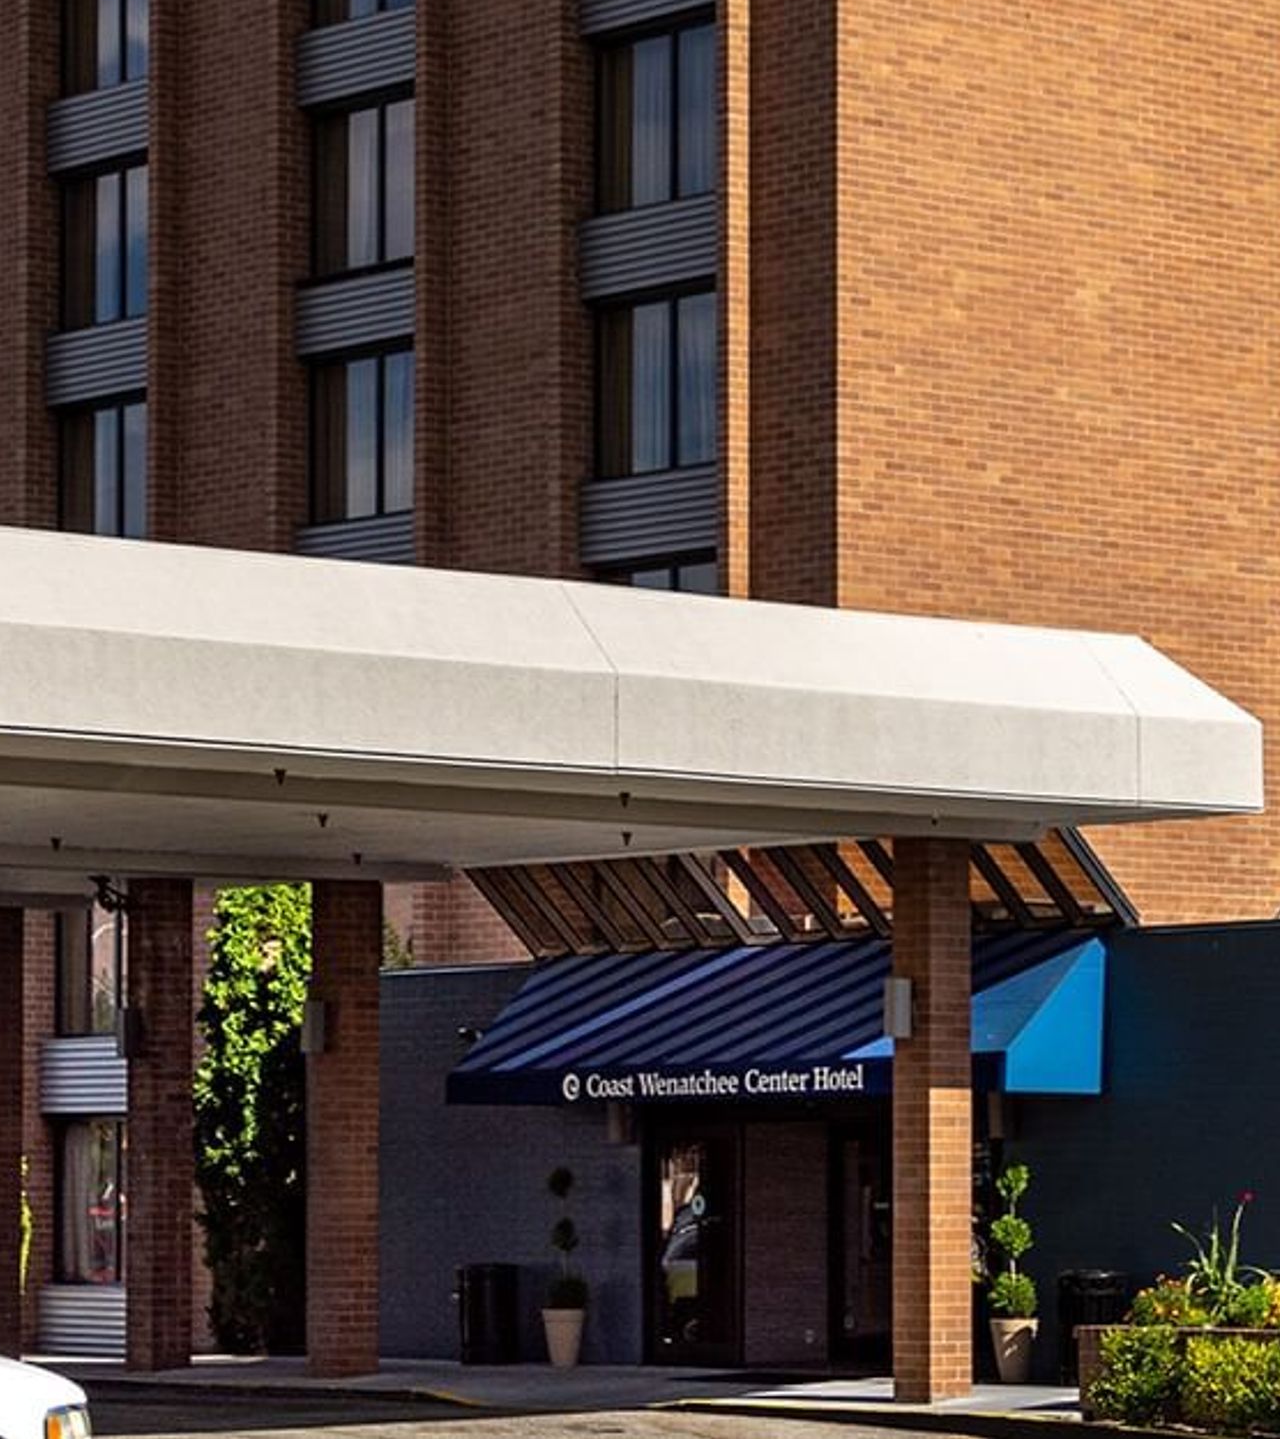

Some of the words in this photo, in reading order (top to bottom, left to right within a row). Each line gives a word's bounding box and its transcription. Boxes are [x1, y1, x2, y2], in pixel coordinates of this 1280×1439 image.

[586, 1072, 634, 1098] Coast
[638, 1069, 739, 1096] Wenatchee
[744, 1068, 810, 1093] Center
[813, 1063, 864, 1091] Hotel
